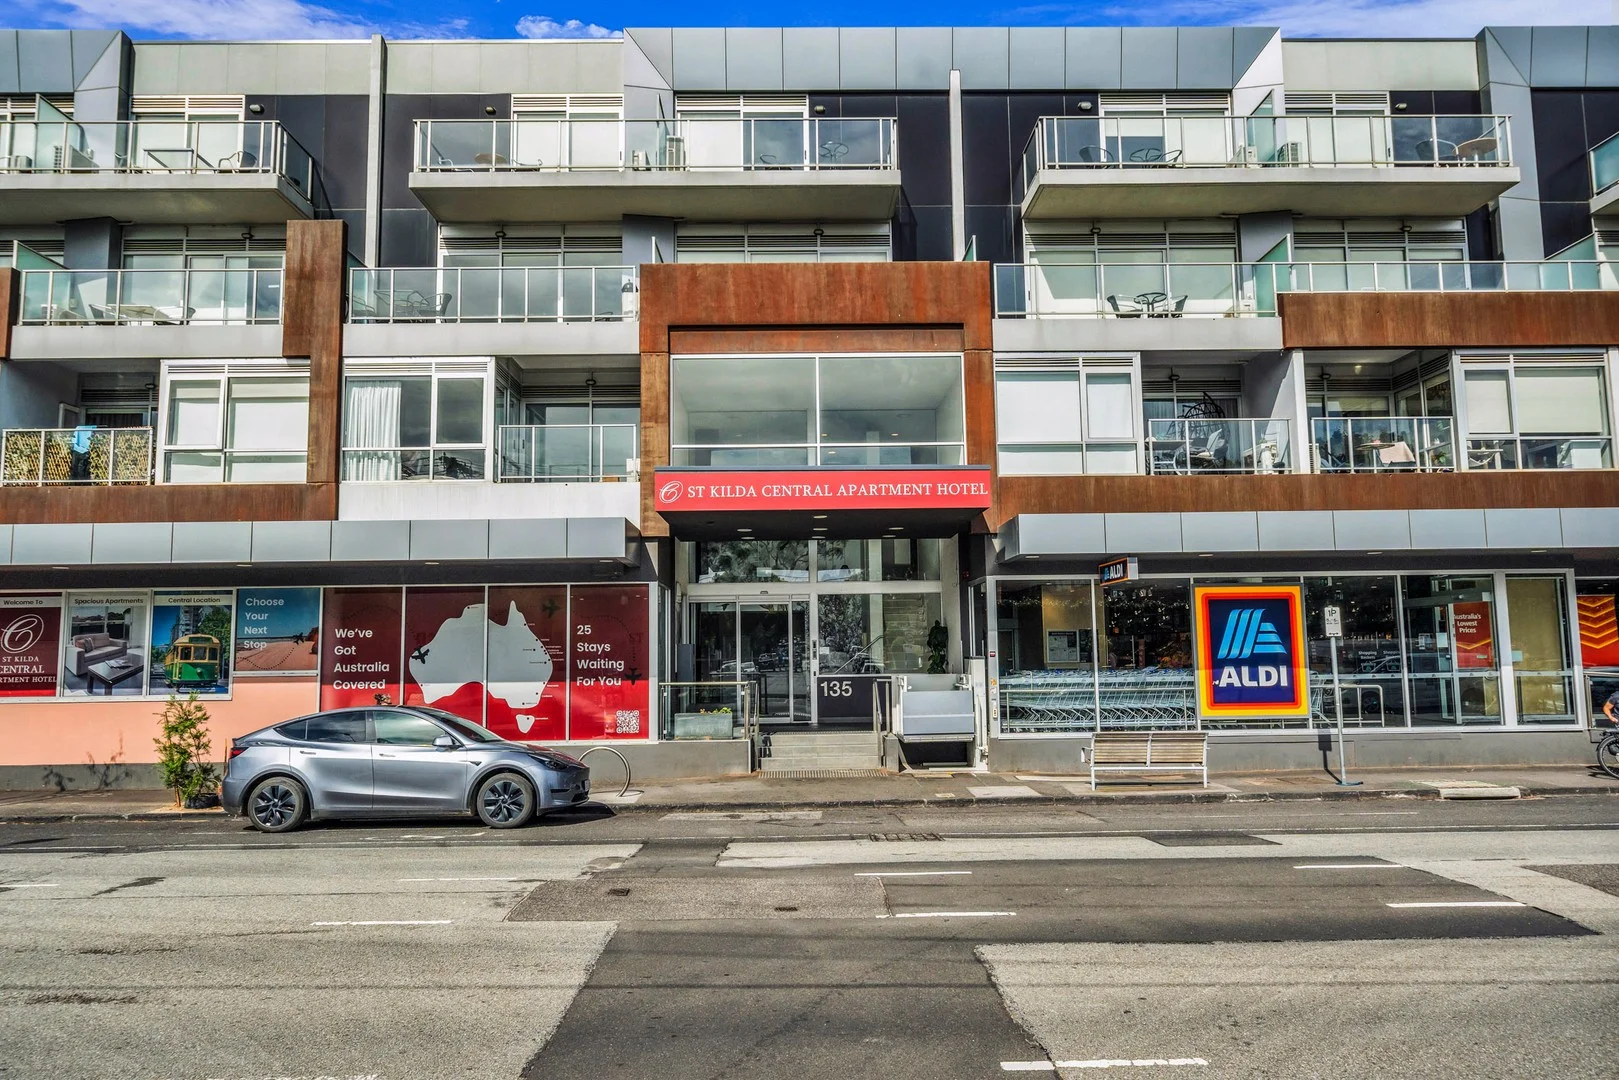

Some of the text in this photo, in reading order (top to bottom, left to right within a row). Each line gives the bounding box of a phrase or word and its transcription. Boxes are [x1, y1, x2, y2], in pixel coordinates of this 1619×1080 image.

[687, 485, 706, 498] ST
[710, 485, 757, 497] KILDA
[761, 484, 832, 497] CENTRAL
[836, 483, 933, 497] APARTMENT
[937, 483, 988, 496] HOTEL
[1109, 563, 1124, 580] ALDI
[245, 598, 284, 606] Choose
[245, 612, 268, 620] Your
[244, 626, 267, 635] Next
[576, 625, 592, 635] 25
[243, 640, 267, 650] Stop
[334, 645, 356, 655] Got
[576, 642, 611, 653] Stays
[333, 662, 390, 673] Australia
[576, 658, 625, 671] Waiting
[576, 676, 622, 686] For You
[1219, 665, 1288, 687] ALDI
[333, 679, 386, 690] Covered
[820, 681, 853, 697] 135
